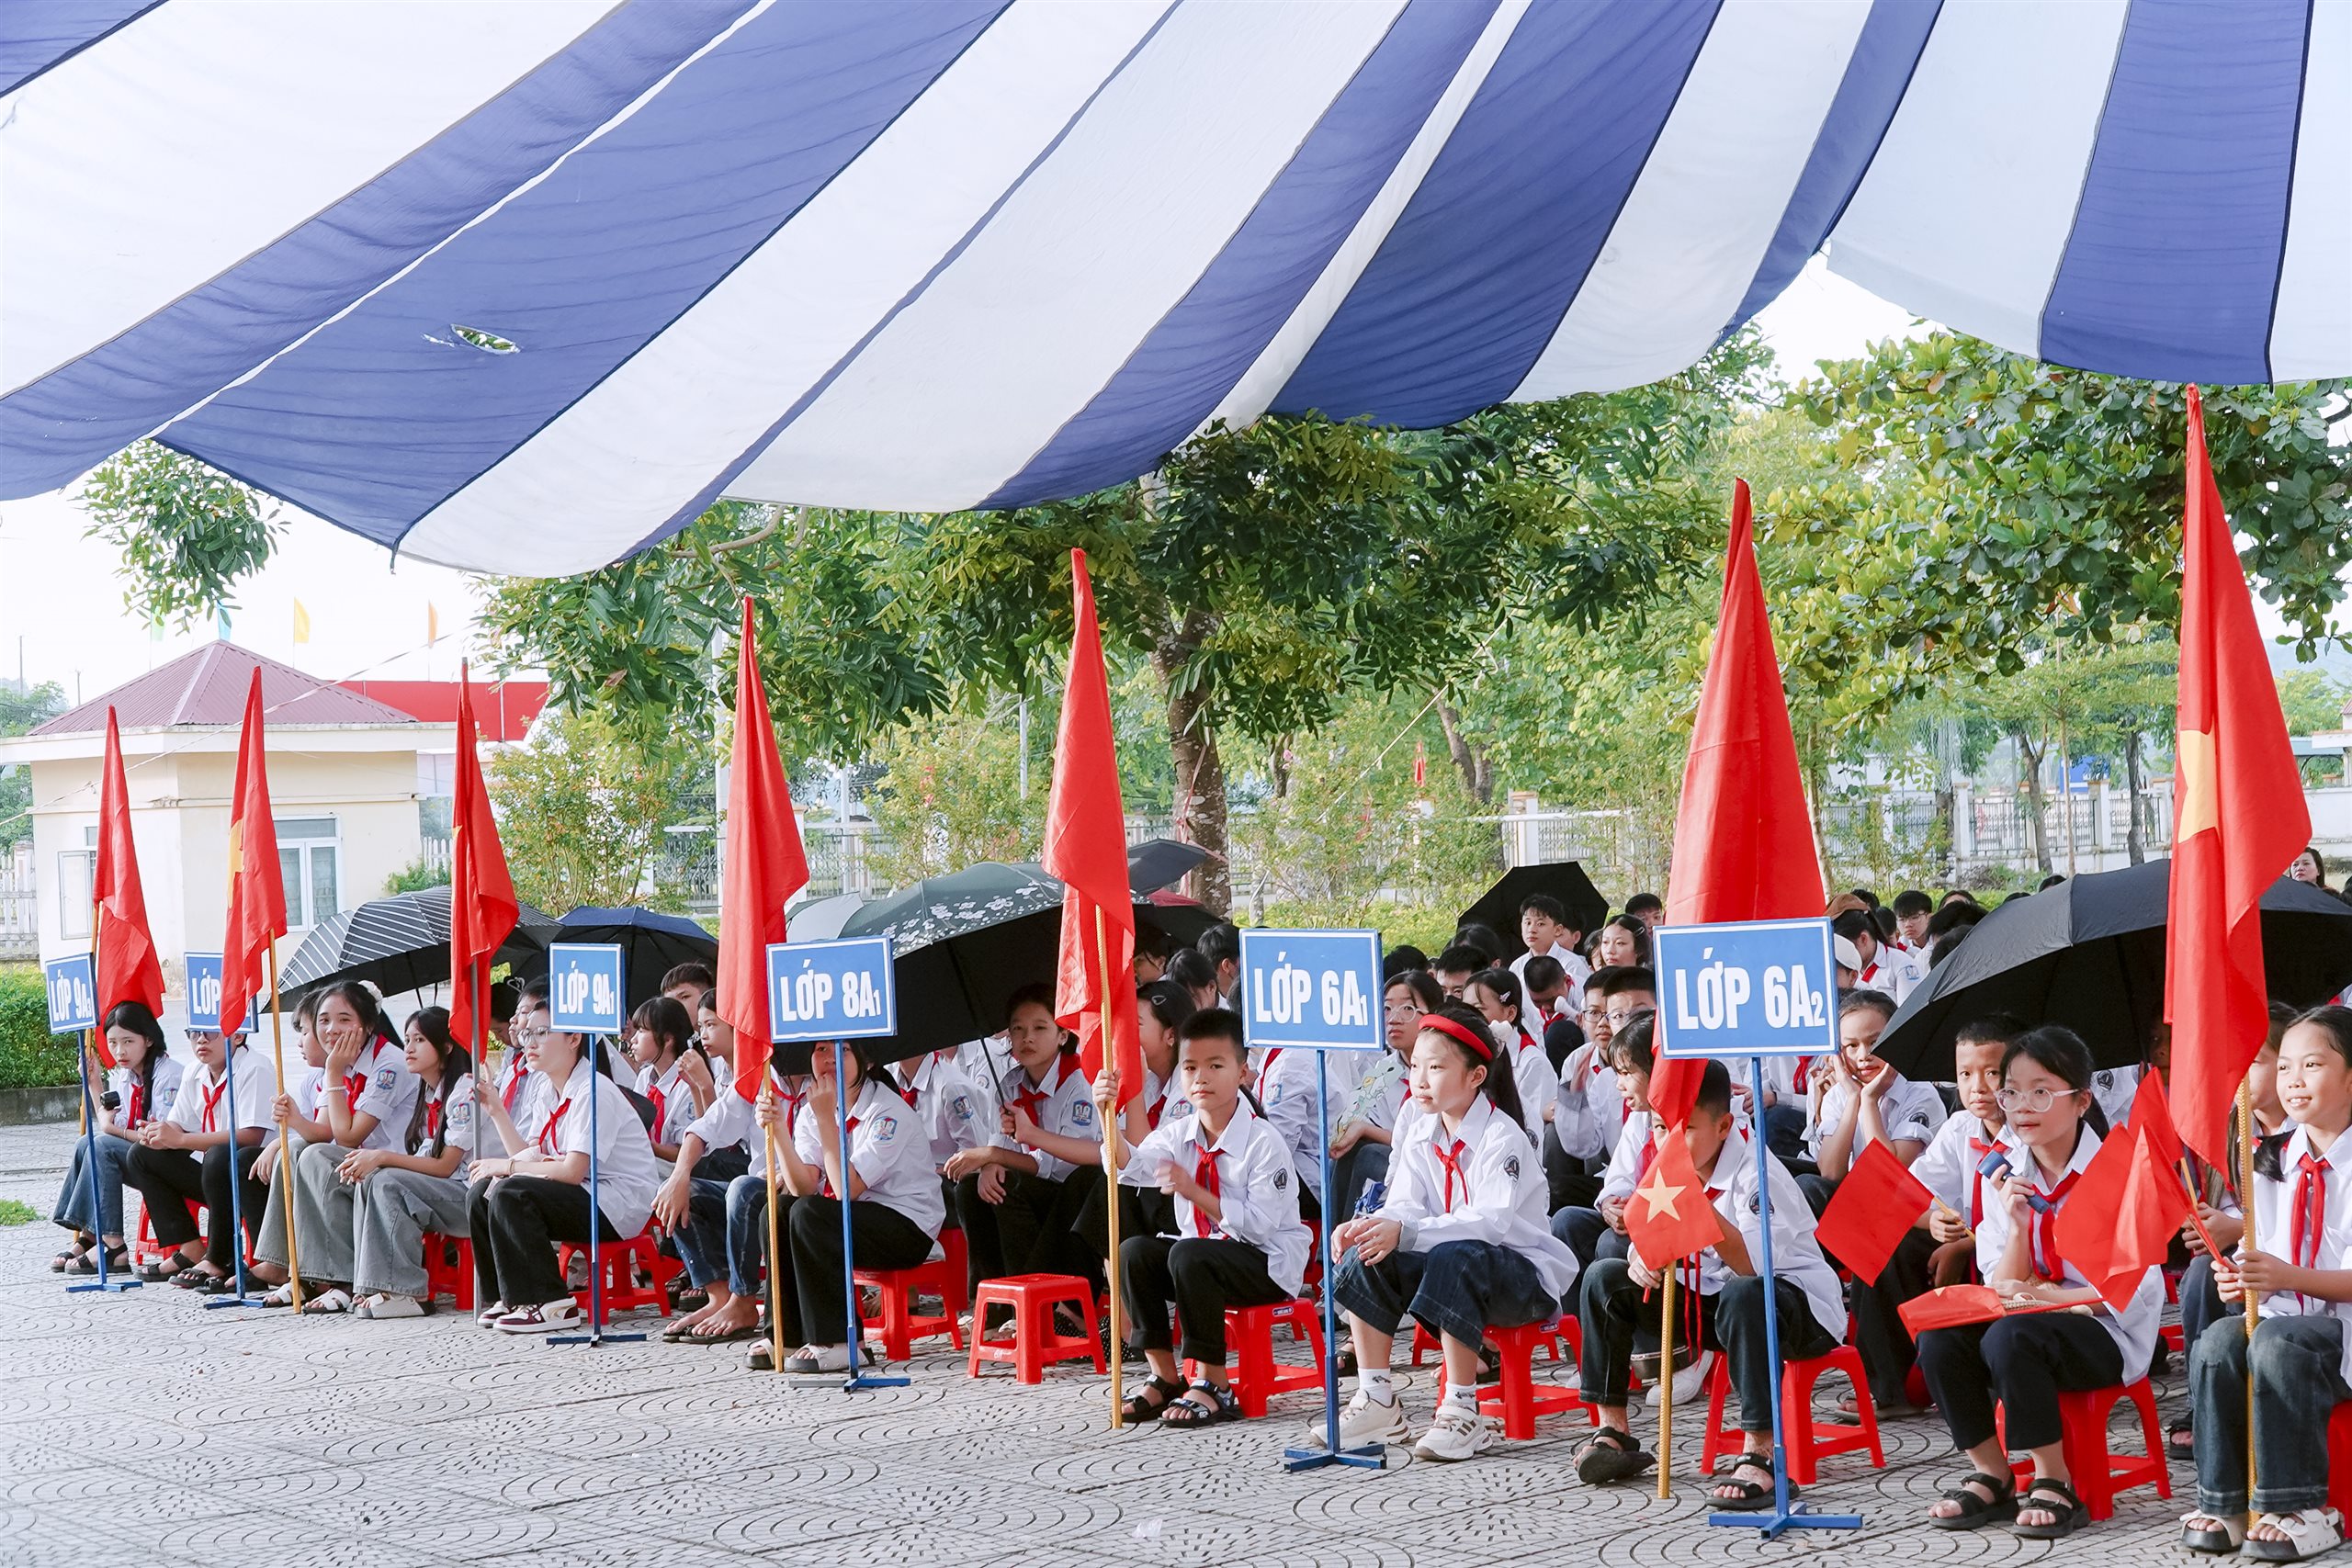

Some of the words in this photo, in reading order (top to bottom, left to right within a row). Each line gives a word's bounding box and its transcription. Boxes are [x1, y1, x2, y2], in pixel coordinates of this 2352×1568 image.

[50, 968, 72, 1022] LỚP
[191, 967, 221, 1015] LỚP
[558, 960, 589, 1014] LỚP
[593, 973, 615, 1015] 9A1
[780, 958, 832, 1022] LỚP
[842, 971, 881, 1019] 8A1
[1254, 951, 1312, 1024] LỚP
[1321, 970, 1368, 1026] 6A1
[1675, 947, 1751, 1030] LỚP
[1763, 964, 1826, 1029] 6A2
